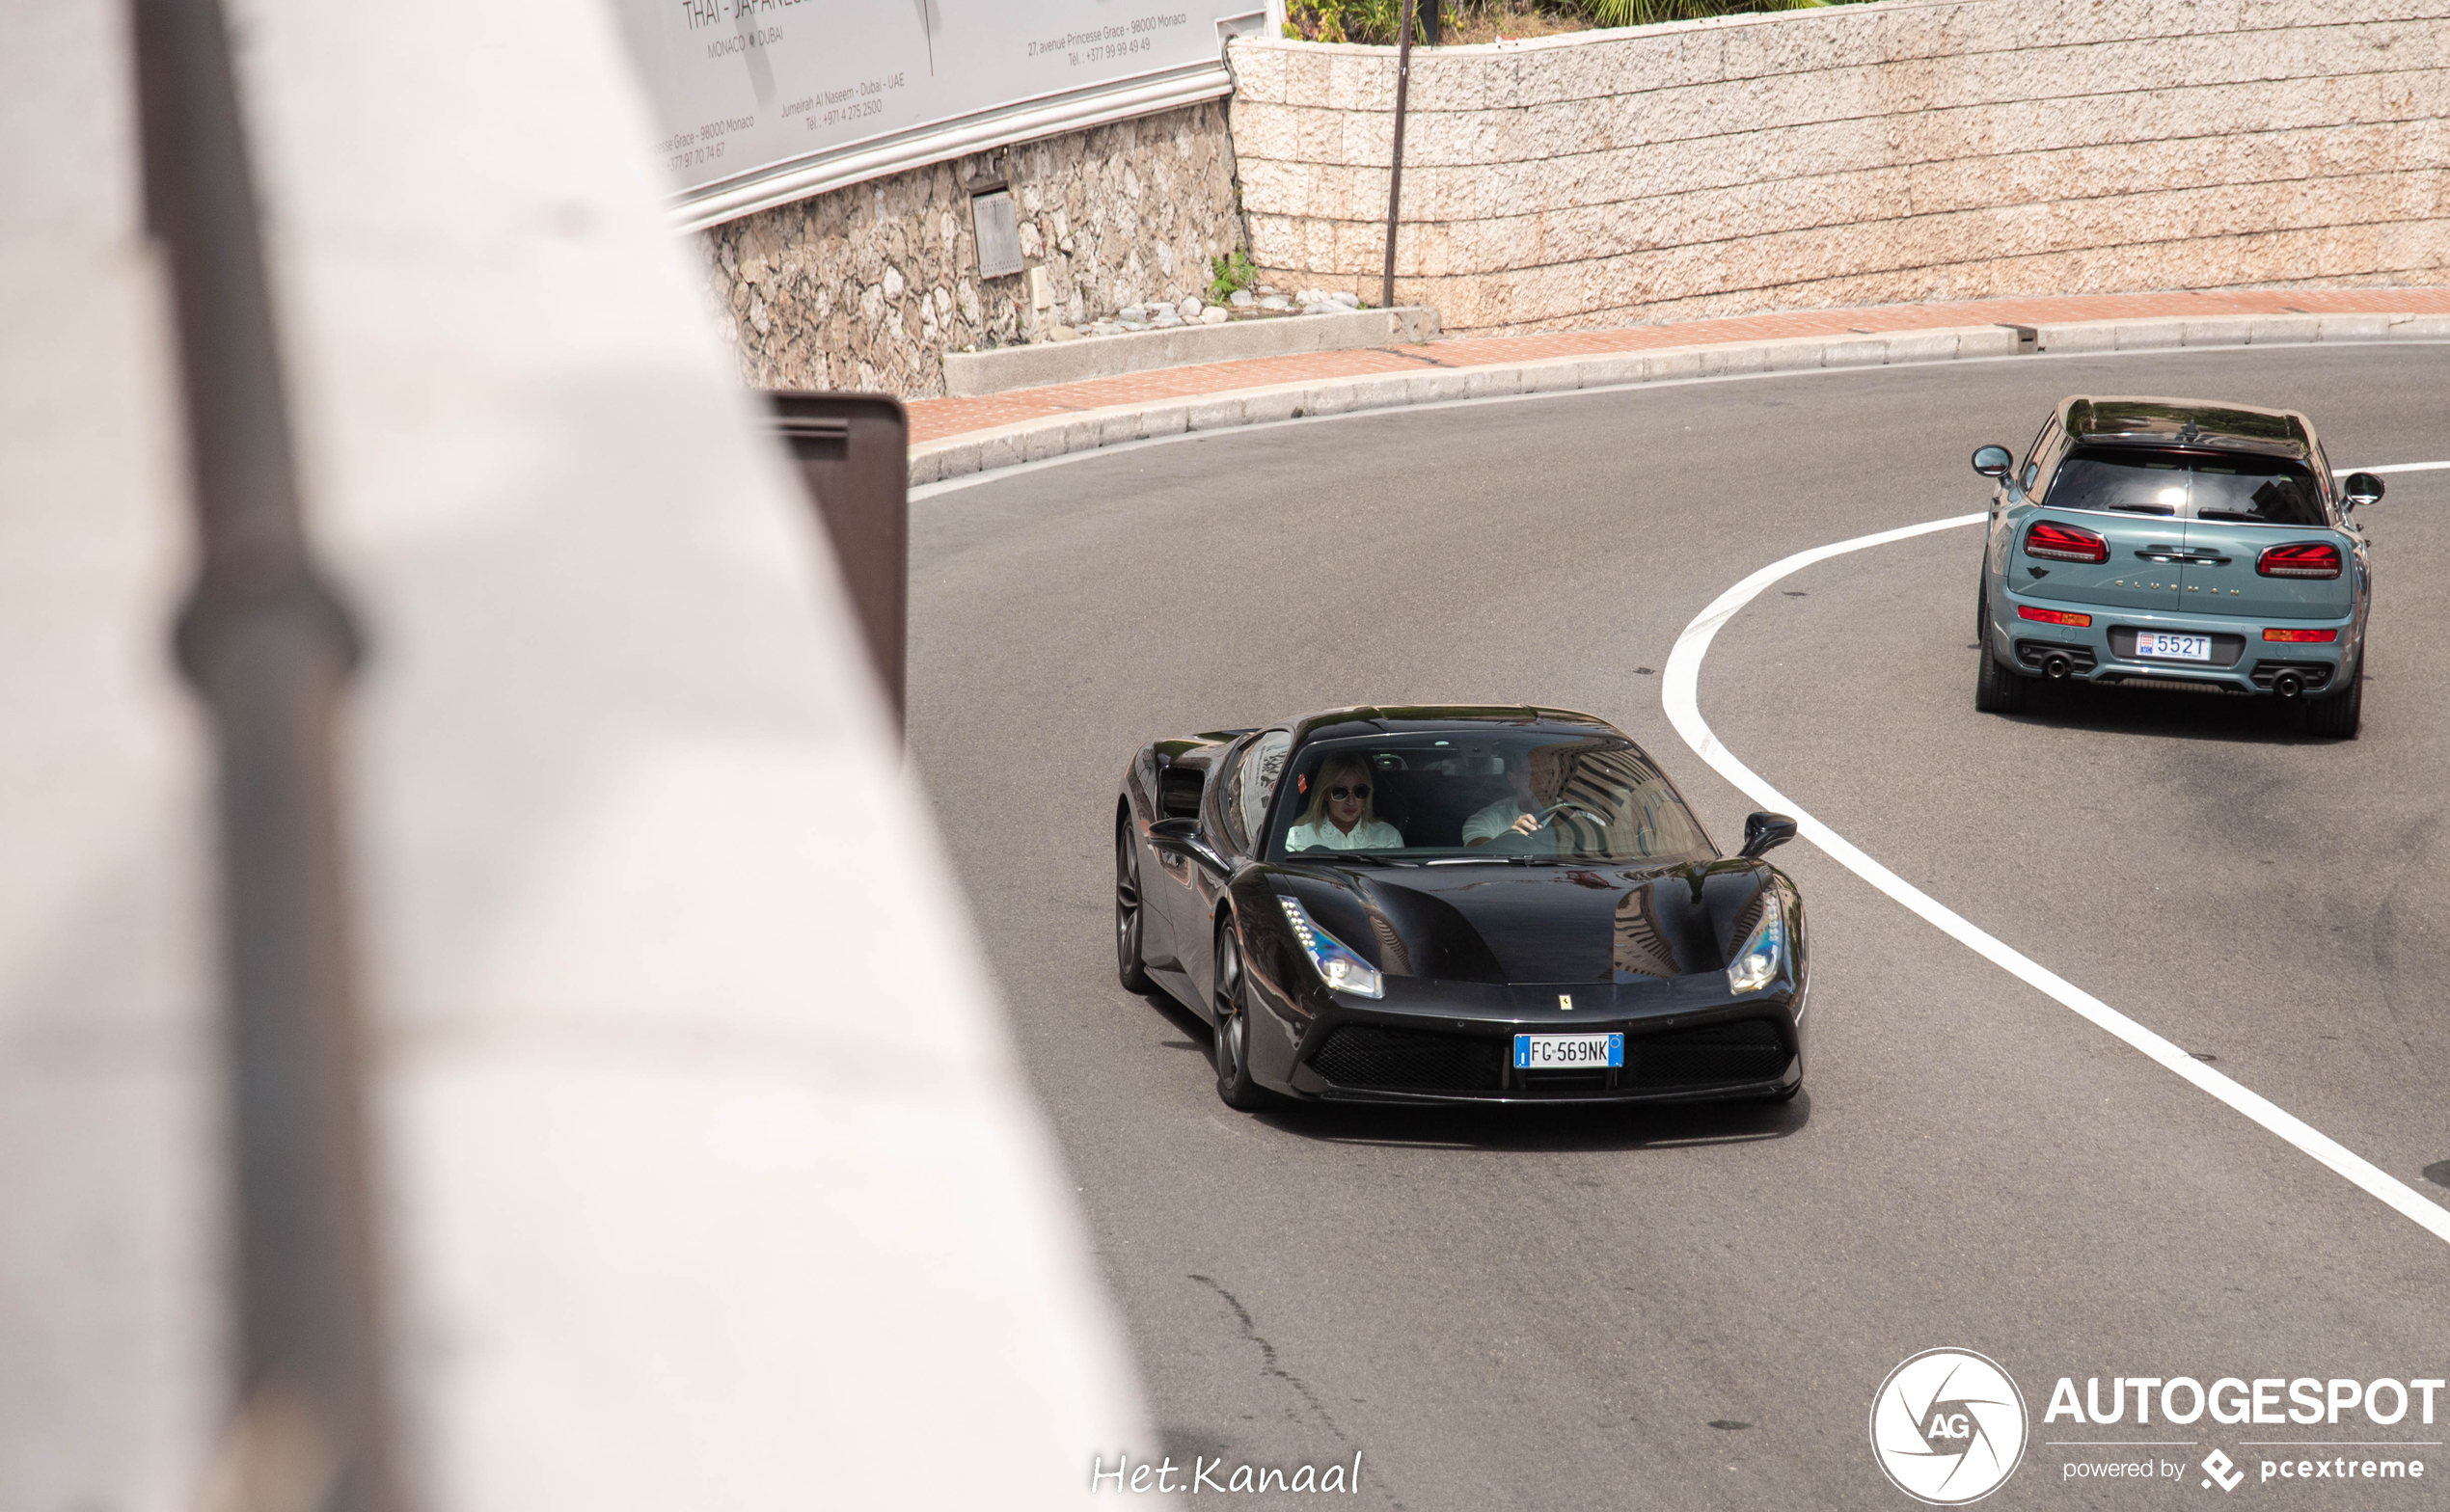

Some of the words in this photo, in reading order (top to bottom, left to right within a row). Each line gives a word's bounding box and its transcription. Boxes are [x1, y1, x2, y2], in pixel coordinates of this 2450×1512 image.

[683, 0, 721, 30] THAI
[707, 35, 746, 59] MONACO
[758, 25, 783, 46] DUBAI
[1028, 41, 1039, 57] 27,
[1040, 39, 1066, 54] avenue
[1067, 30, 1102, 47] Princesse
[1102, 26, 1125, 40] Grace
[1130, 16, 1157, 34] 98000
[1157, 13, 1186, 29] Monaco
[1086, 46, 1103, 62] +377
[1105, 44, 1116, 59] 99
[1117, 41, 1128, 56] 99
[1129, 39, 1139, 53] 49
[1140, 37, 1151, 51] 49
[781, 95, 814, 119] Jumeirah
[825, 88, 855, 106] Naseem
[859, 77, 882, 96] Dubai
[887, 72, 905, 90] UAE
[848, 103, 861, 121] 275
[862, 98, 883, 117] 2500
[673, 132, 694, 149] Grace
[700, 121, 725, 141] 98000
[725, 116, 755, 133] Monaco
[684, 151, 694, 168] 97
[694, 148, 704, 164] 70
[705, 145, 715, 161] 74
[716, 141, 725, 158] 67
[2115, 580, 2240, 596] CLUBMAN
[2158, 635, 2206, 655] 552T
